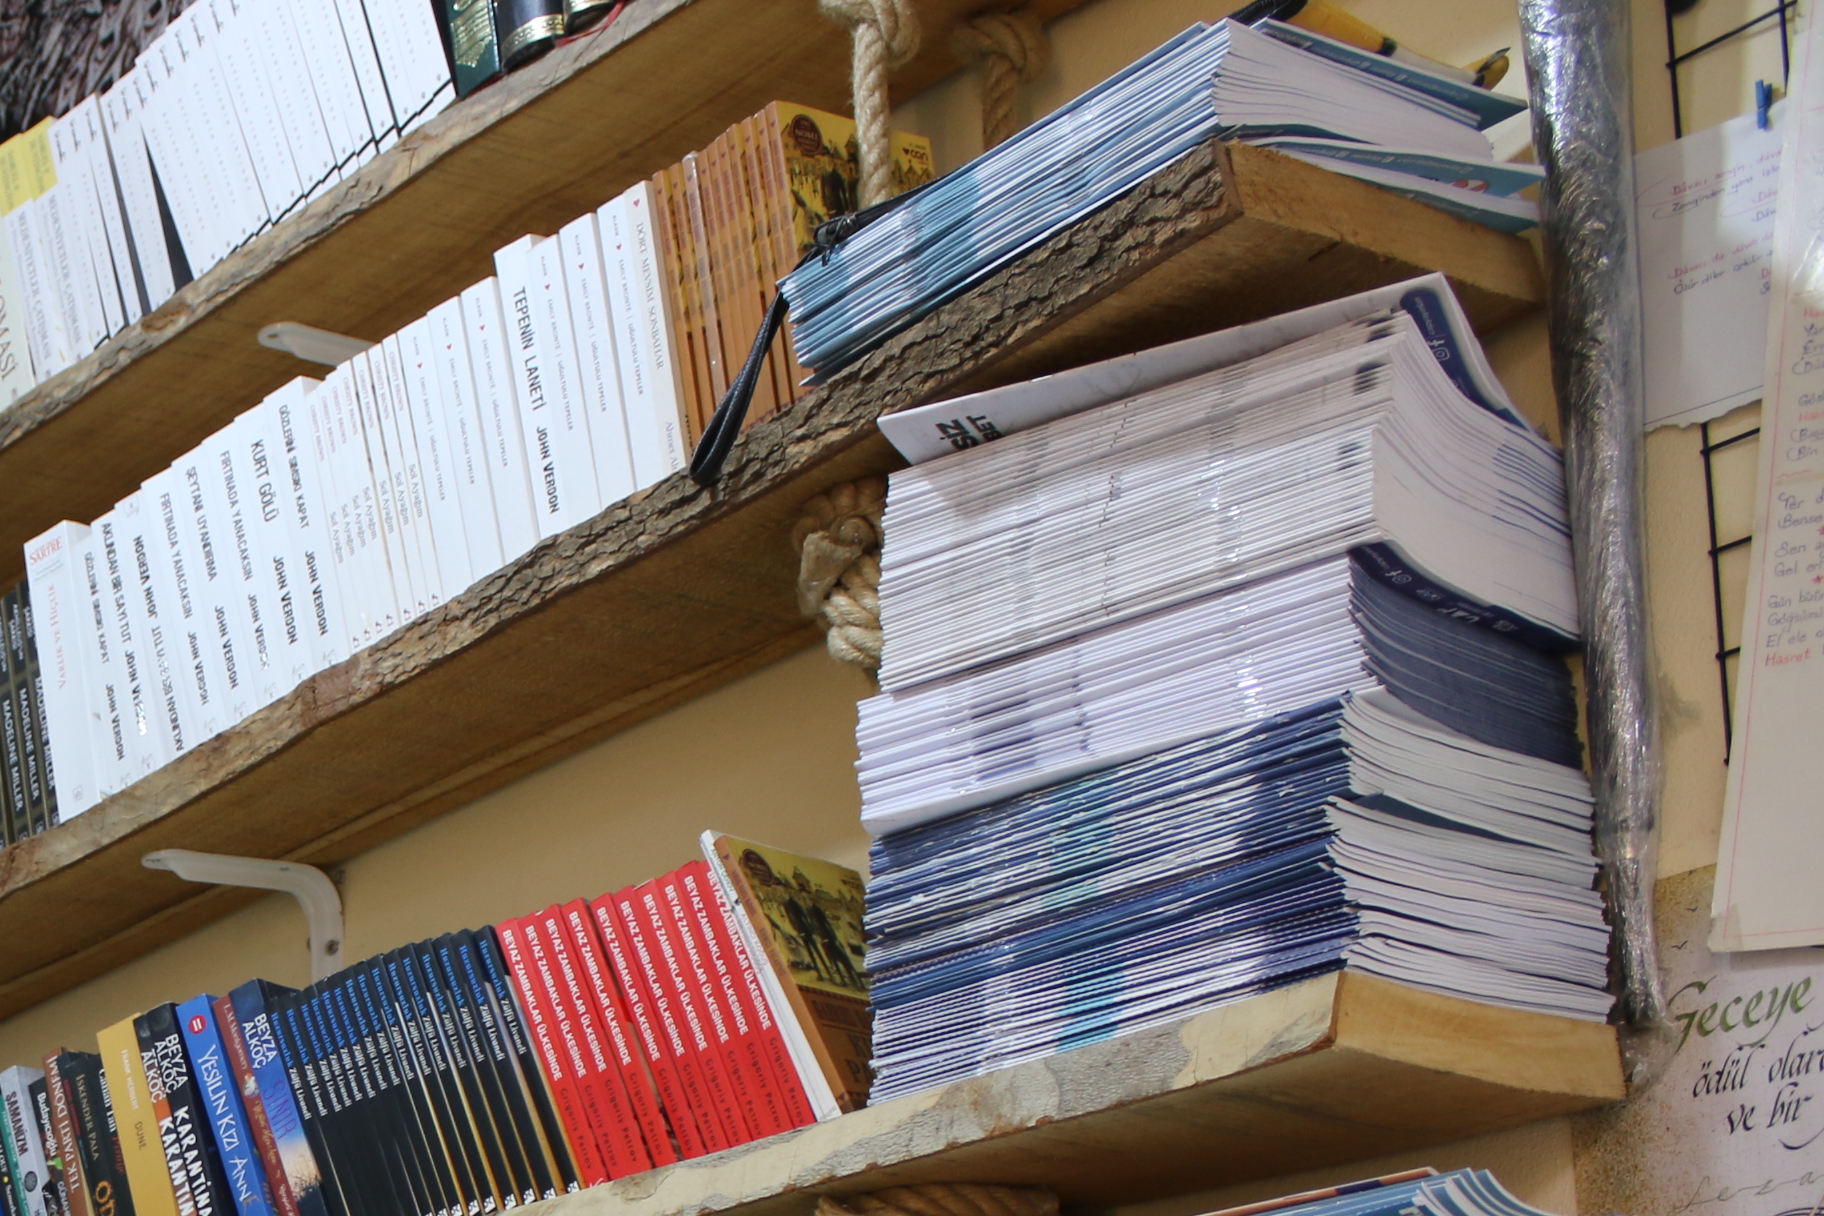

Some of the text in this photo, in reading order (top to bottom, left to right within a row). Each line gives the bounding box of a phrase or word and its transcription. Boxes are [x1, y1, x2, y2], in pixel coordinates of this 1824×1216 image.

[512, 285, 561, 514] TEPENİN LANETİ JOHN VERDON
[185, 466, 240, 690] ŞEYTANI UYANDIRMA JOHN VERDON
[220, 450, 239, 507] FIRTINADA
[233, 509, 254, 581] YANACAKSIN
[248, 594, 261, 626] JOHN
[250, 439, 299, 645] KURT GÖLÜ JOHN VERDON
[160, 492, 210, 706] FIRTINADA YANACAKSIN JOHN VERDON
[2, 699, 24, 812] MADELINE MILLER
[478, 940, 529, 1056] Huzursuzluk Zülfü Livaneli
[502, 929, 522, 962] BEYAZ
[514, 962, 544, 1020] ZAMBAKLAR
[536, 1019, 564, 1082] ÜLKESİNDE
[683, 874, 705, 909] BEYAZ
[694, 909, 728, 973] ZAMBAKLAR
[721, 973, 750, 1036] ÜLKESİNDE
[154, 1041, 180, 1094] ALKOÇ
[164, 1032, 191, 1089] BEYZA
[241, 1022, 269, 1069] ALKOÇ
[253, 1013, 280, 1063] BEYZA
[1667, 974, 1815, 1053] Geceye
[4, 1091, 30, 1157] ŞAMANİZM
[134, 1121, 149, 1150] DUNE
[197, 1044, 256, 1215] YEŞİLİN KIZI ANNE
[1726, 1081, 1815, 1137] ve bir
